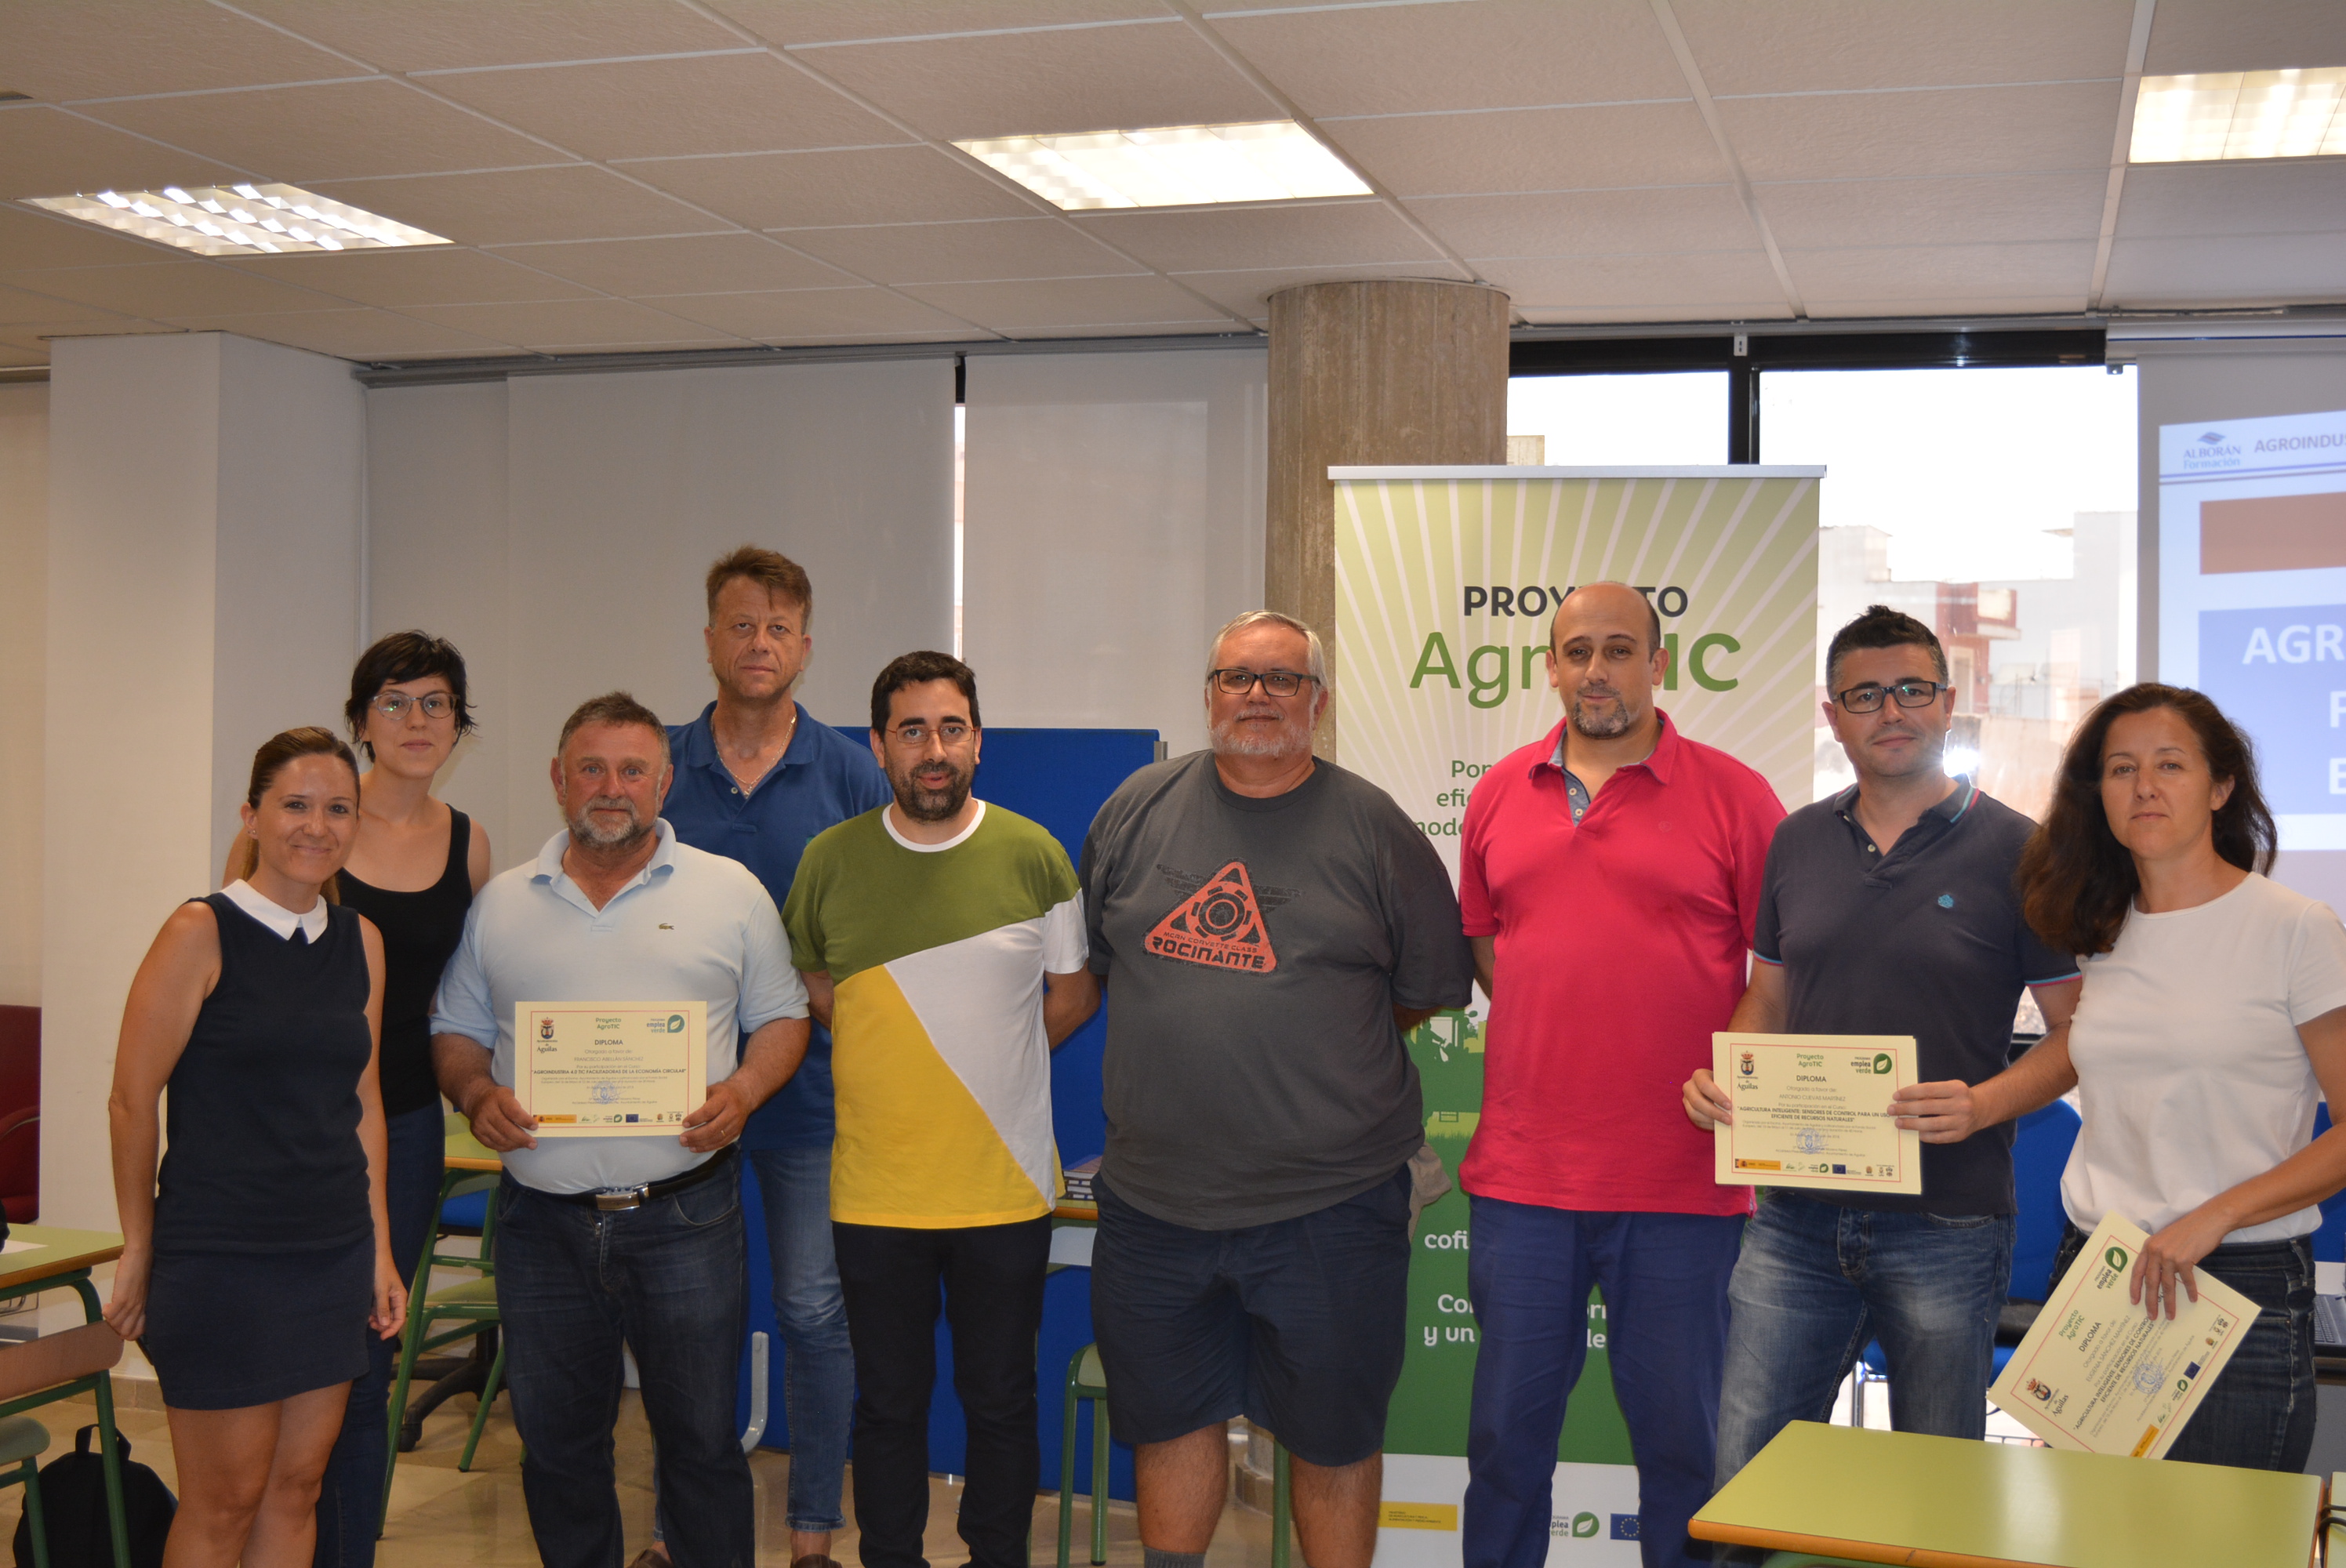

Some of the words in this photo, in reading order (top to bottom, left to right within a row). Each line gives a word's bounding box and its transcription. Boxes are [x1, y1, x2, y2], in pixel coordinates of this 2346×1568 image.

[2183, 444, 2241, 459] ALBORÁN
[2254, 434, 2346, 453] AGROINDU
[2184, 458, 2241, 470] Formación
[1464, 586, 1688, 618] PROYTO
[1409, 631, 1741, 709] AgrIC
[1152, 936, 1265, 969] ROCINANTE
[1163, 932, 1186, 940] MCRN
[1188, 938, 1229, 949] CORVETTE
[1231, 945, 1257, 953] CLASS
[2096, 1268, 2112, 1289] emplea
[2105, 1273, 2117, 1288] verde
[2059, 1309, 2079, 1336] Proyecto
[2066, 1315, 2085, 1340] AgroTIC
[1424, 1327, 1438, 1347] y
[2079, 1321, 2100, 1351] DIPLOMA
[2114, 1345, 2130, 1368] SENSORES
[2086, 1360, 2101, 1381] EUGENIA
[2101, 1380, 2116, 1402] EFICIENTE
[2120, 1349, 2136, 1372] RECURSOS
[1552, 1520, 1569, 1529] plea
